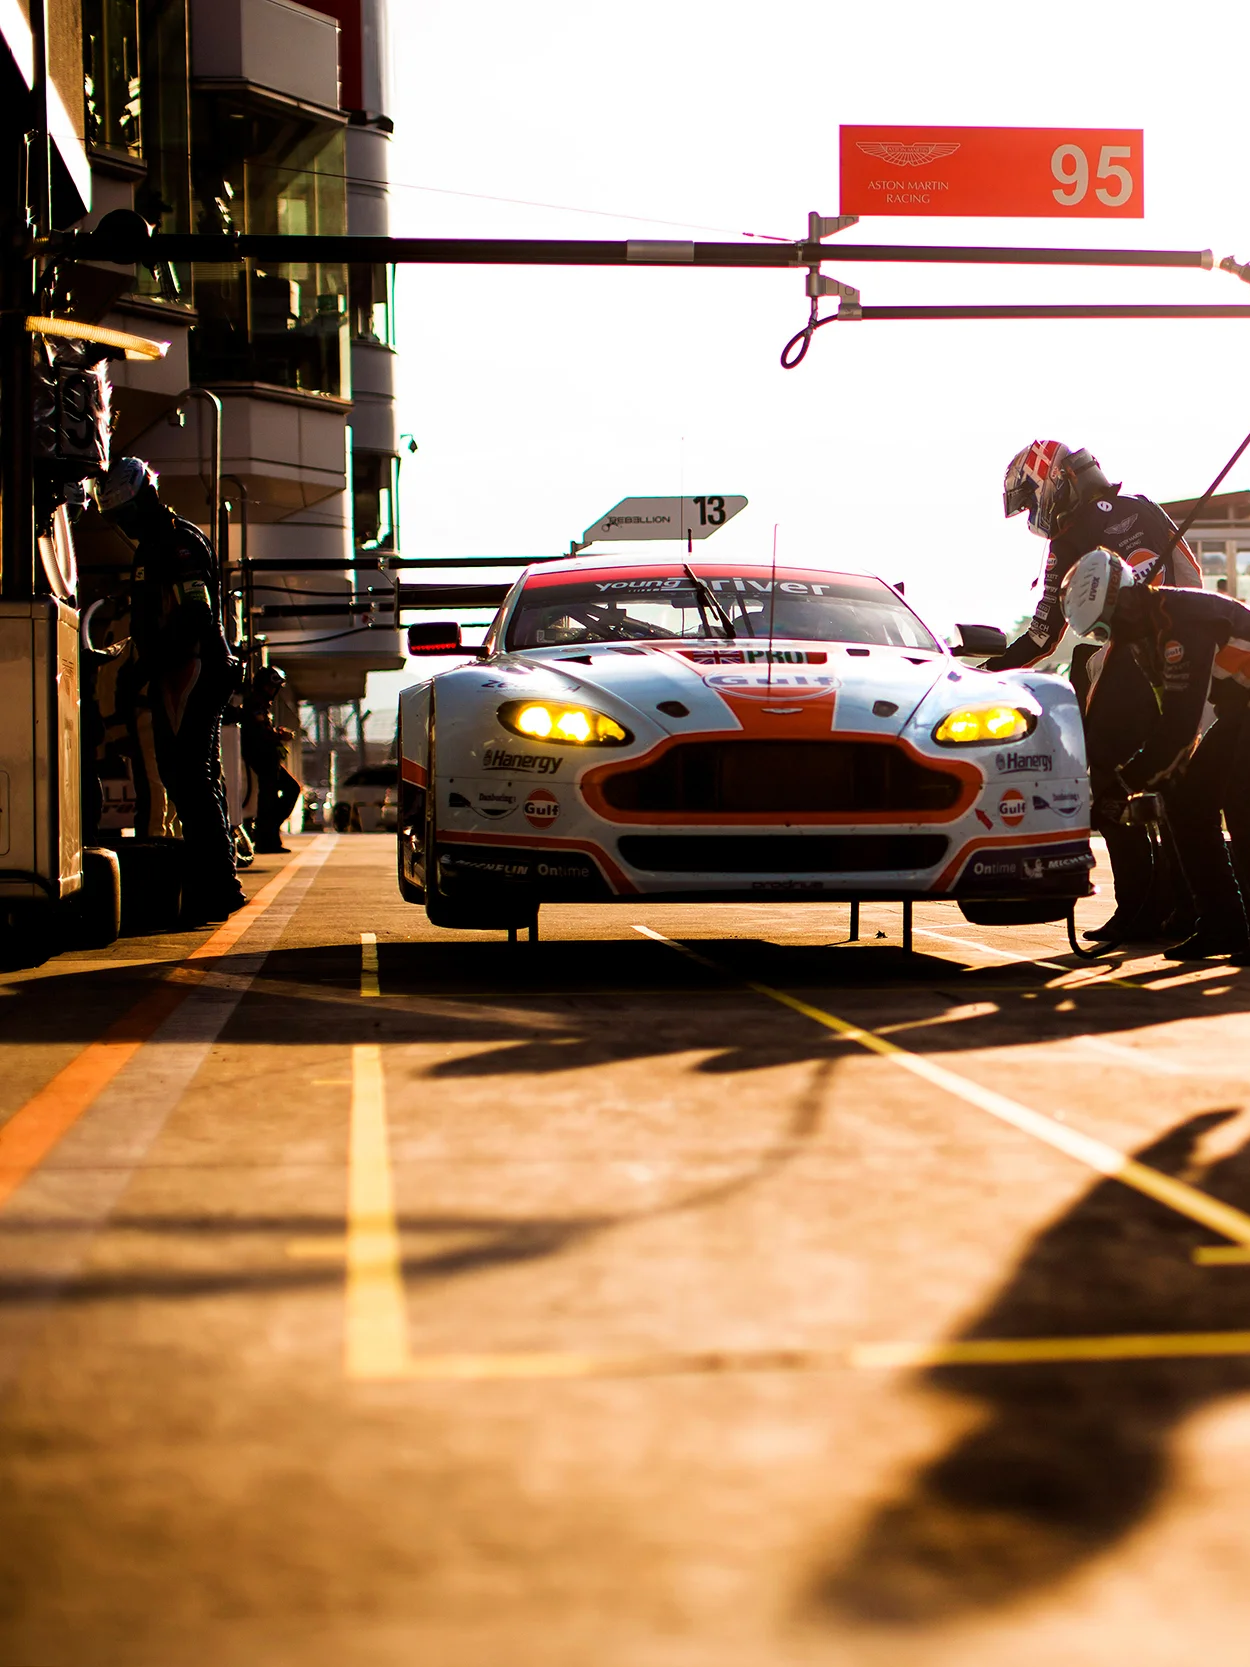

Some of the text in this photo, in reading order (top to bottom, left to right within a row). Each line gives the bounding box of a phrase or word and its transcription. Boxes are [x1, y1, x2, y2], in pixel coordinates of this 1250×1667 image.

[1051, 144, 1133, 206] 95
[868, 181, 949, 190] ASTON MARTIN
[886, 194, 930, 203] RACING
[693, 496, 726, 525] 13
[1089, 576, 1100, 601] uvex
[747, 651, 803, 664] PRO
[708, 675, 834, 686] Gulf
[492, 750, 563, 774] Hanergy
[1007, 752, 1052, 772] Hanergy
[524, 802, 560, 816] Gulf
[1000, 802, 1025, 815] Gulf
[537, 863, 589, 877] Ontime
[974, 862, 1016, 875] Ontime
